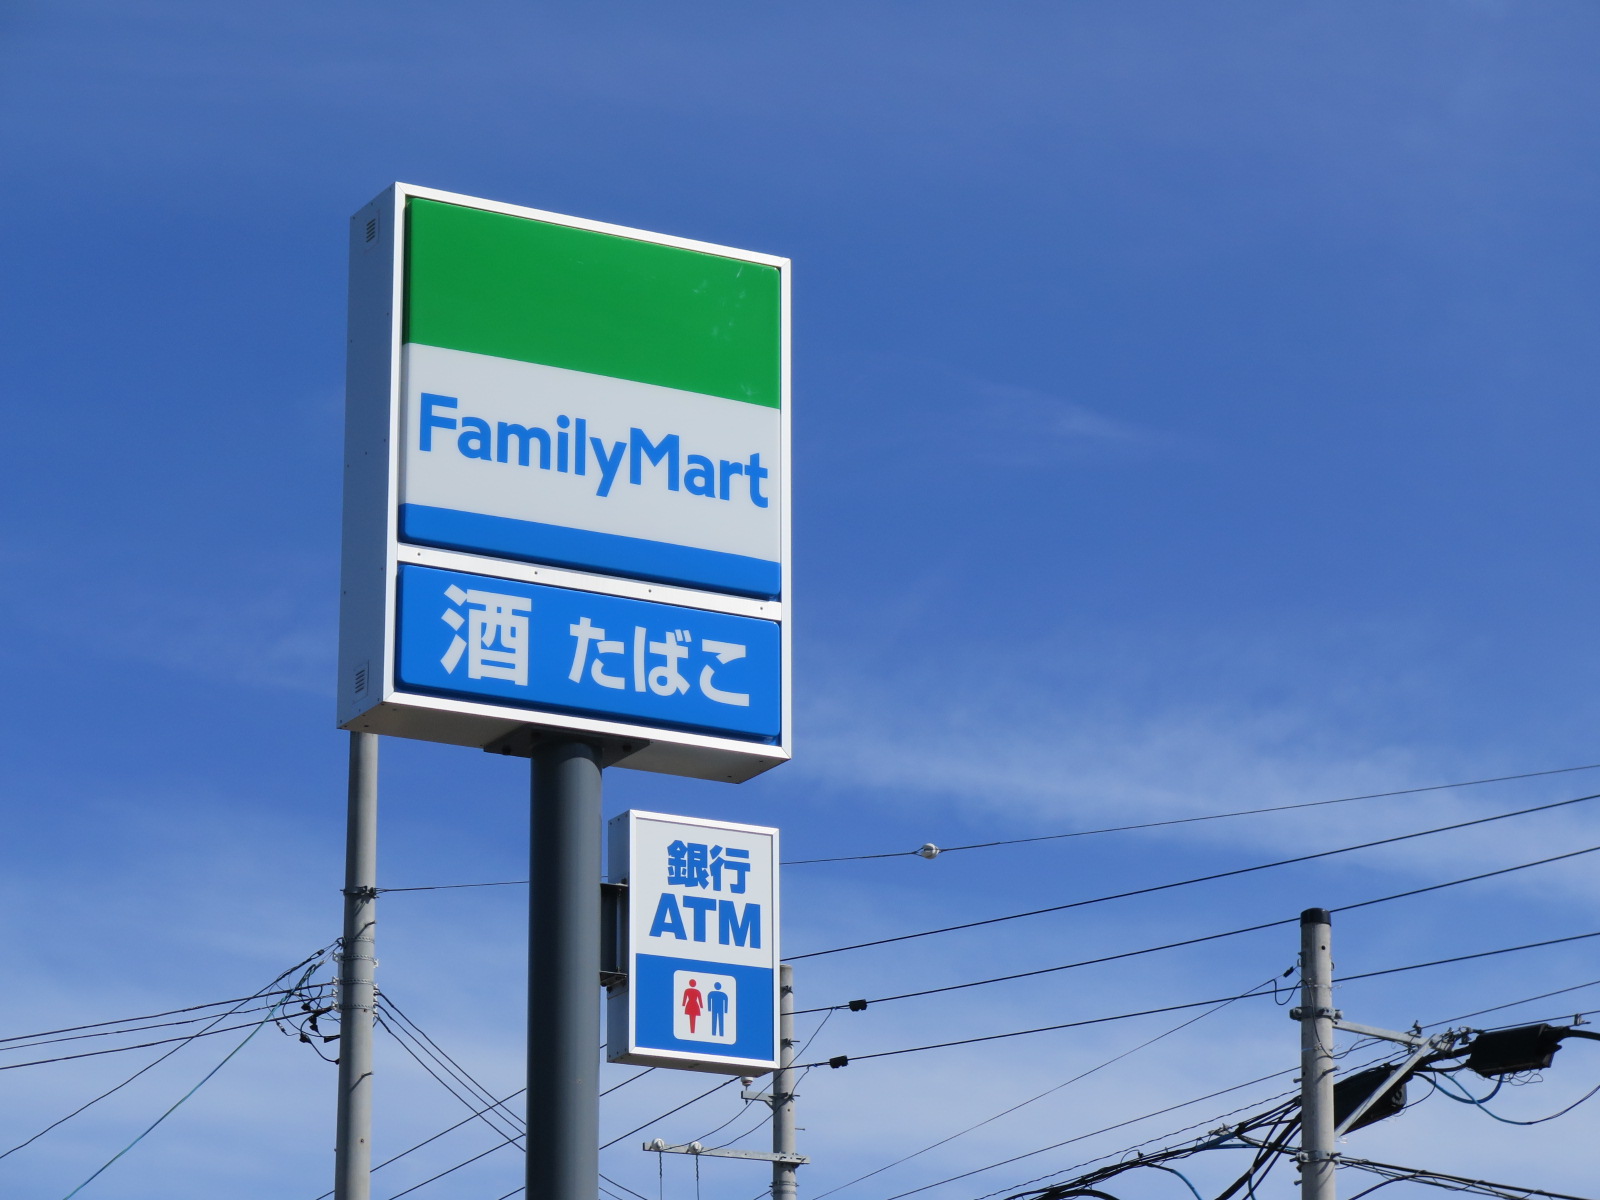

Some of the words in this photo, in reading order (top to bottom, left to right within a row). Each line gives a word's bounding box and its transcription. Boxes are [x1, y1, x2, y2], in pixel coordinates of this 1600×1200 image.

[419, 392, 768, 508] FamilyMart
[441, 584, 532, 687] 酒
[568, 616, 750, 707] たばこ
[667, 839, 751, 895] 銀行
[649, 892, 761, 949] ATM
